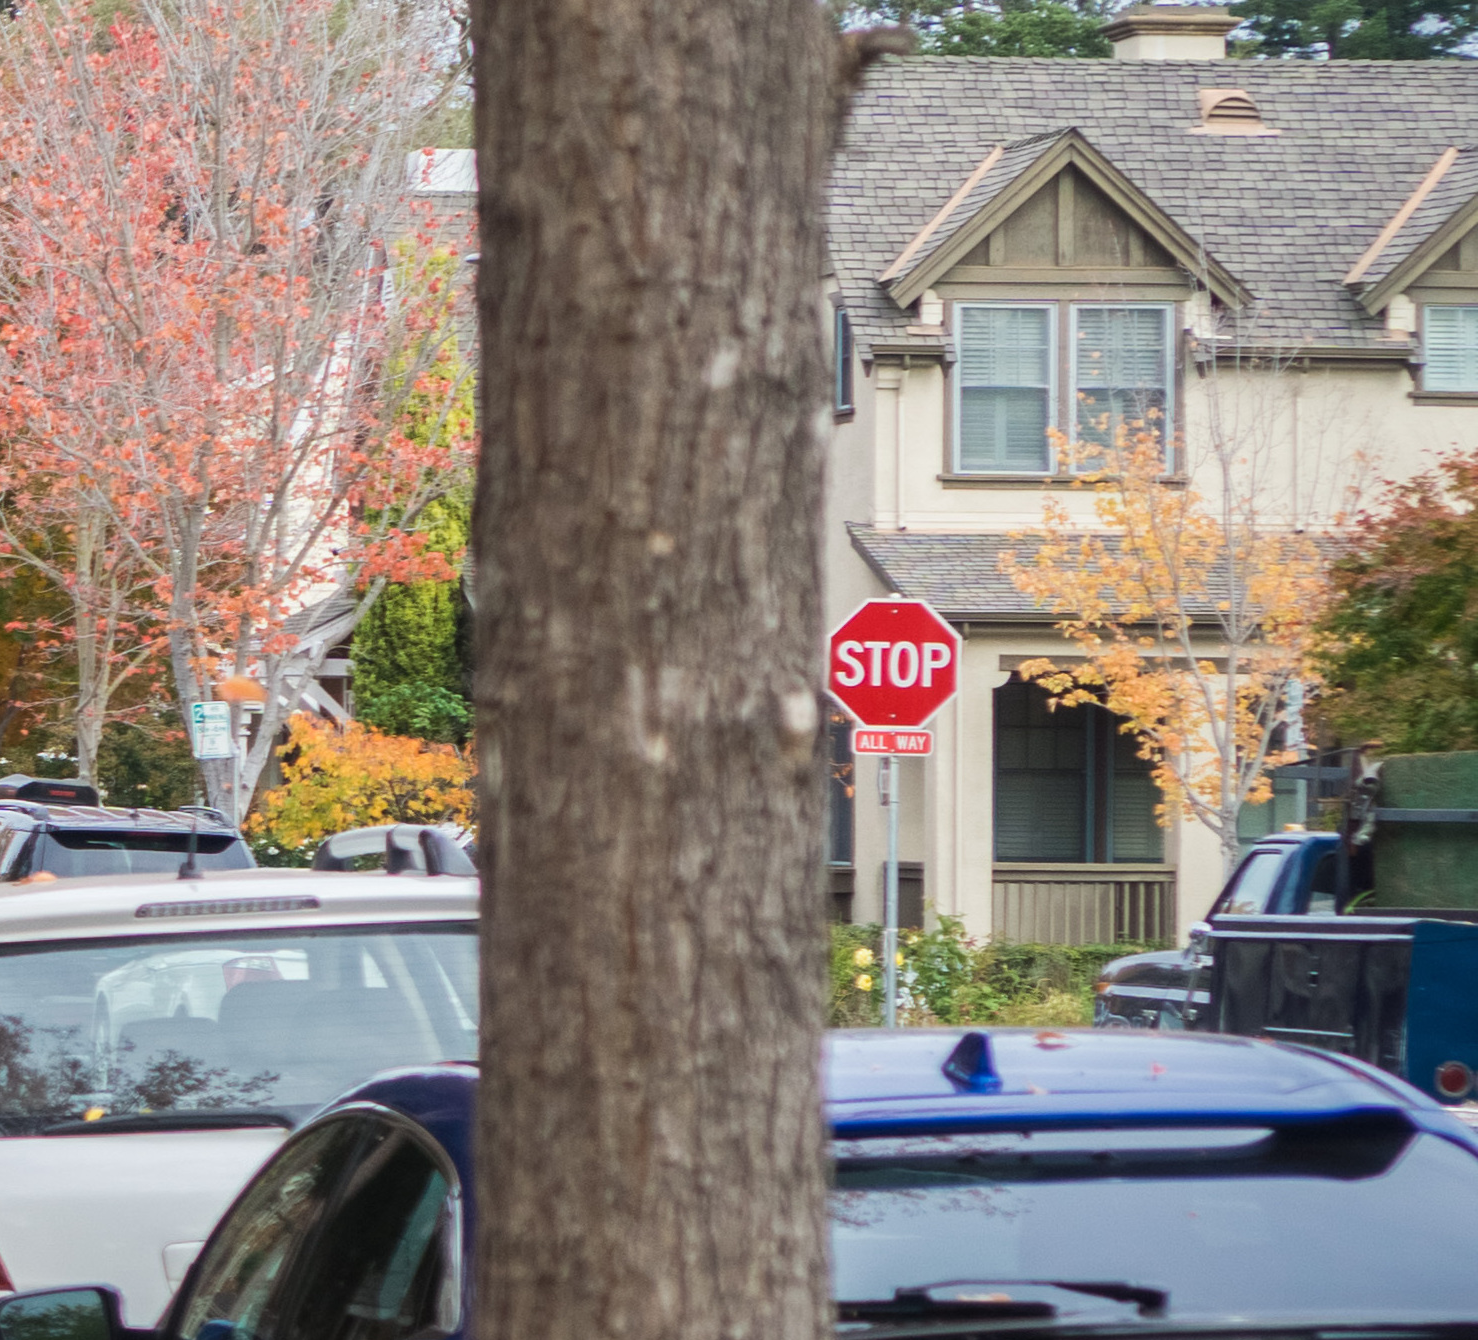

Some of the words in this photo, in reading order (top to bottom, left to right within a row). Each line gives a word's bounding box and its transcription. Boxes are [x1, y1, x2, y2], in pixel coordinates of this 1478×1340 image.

[836, 640, 951, 687] STOP
[861, 736, 888, 749] ALL
[897, 736, 926, 750] WAY
